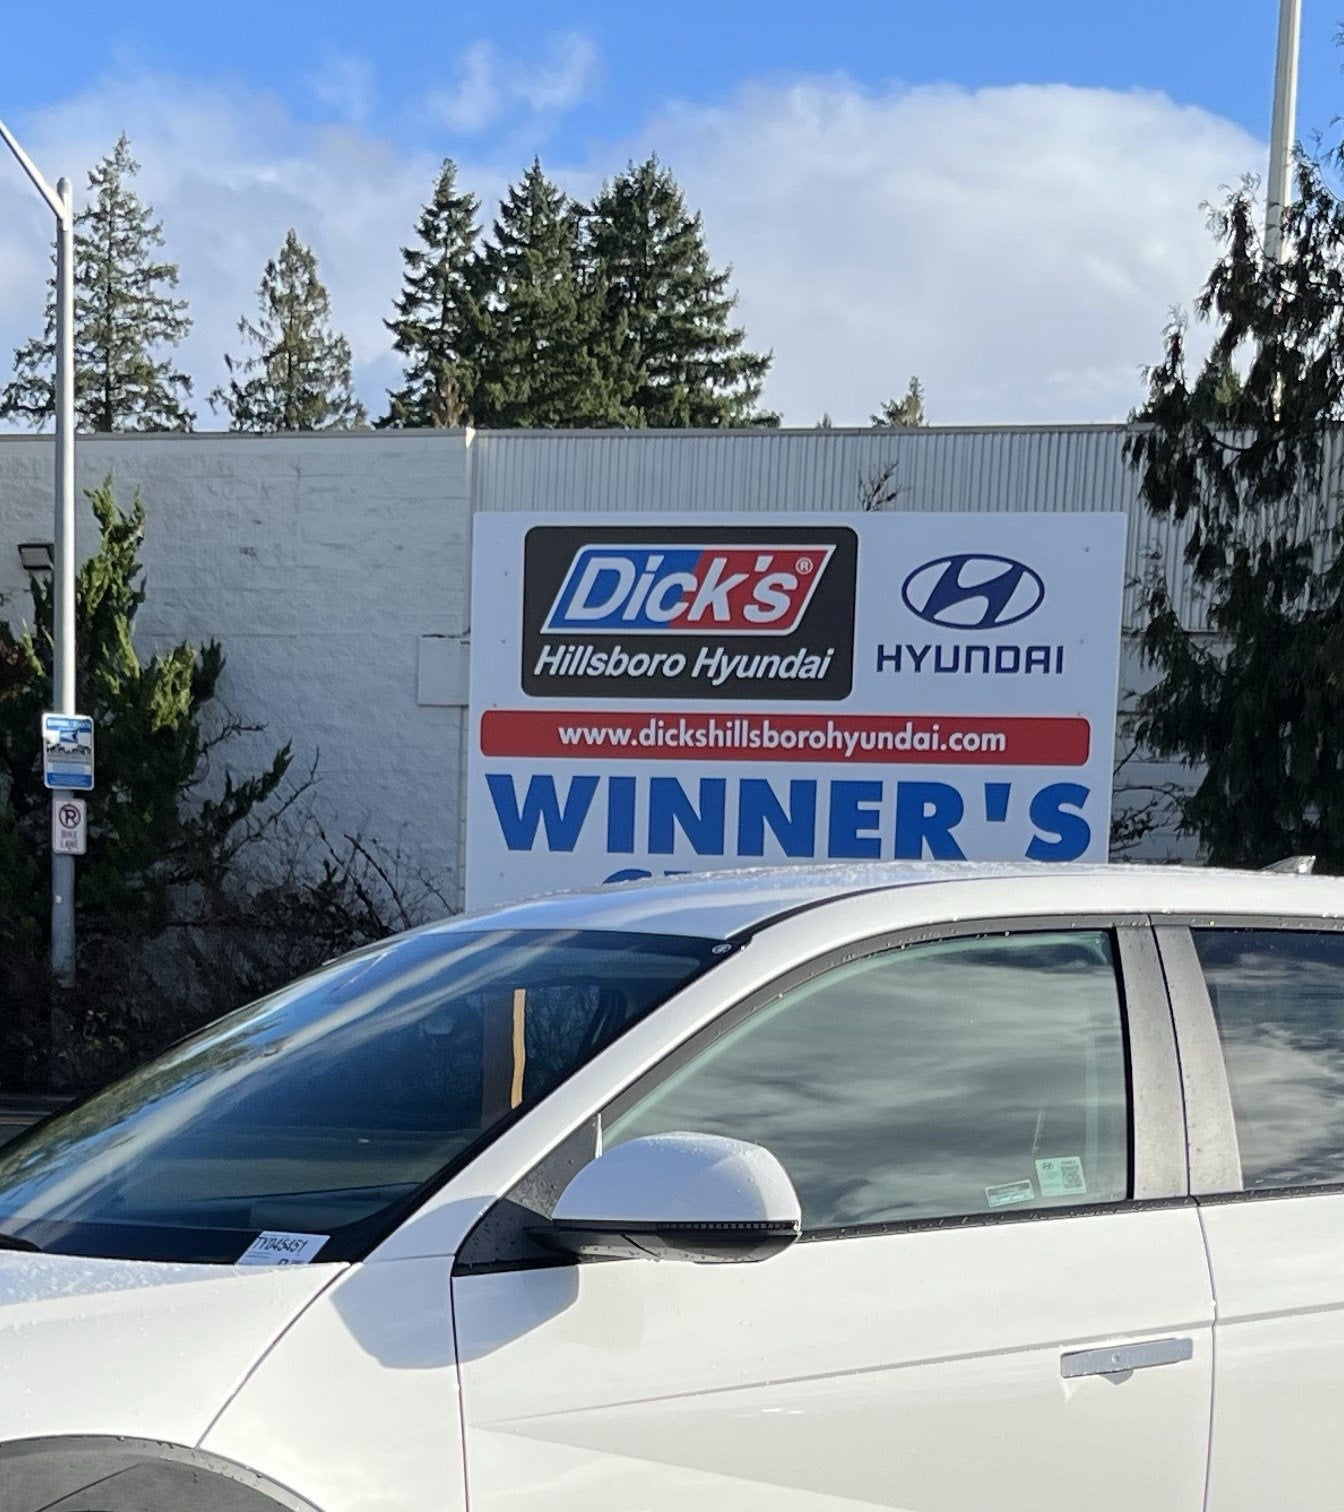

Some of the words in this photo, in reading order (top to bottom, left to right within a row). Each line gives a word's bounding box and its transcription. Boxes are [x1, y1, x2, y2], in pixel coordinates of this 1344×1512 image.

[534, 645, 687, 677] Hillsboro
[691, 647, 835, 686] Hyundai
[876, 644, 1064, 676] HYUNDAI
[558, 720, 1006, 757] www.dickshillsborohyundai.com
[485, 773, 1092, 862] WINNER'S
